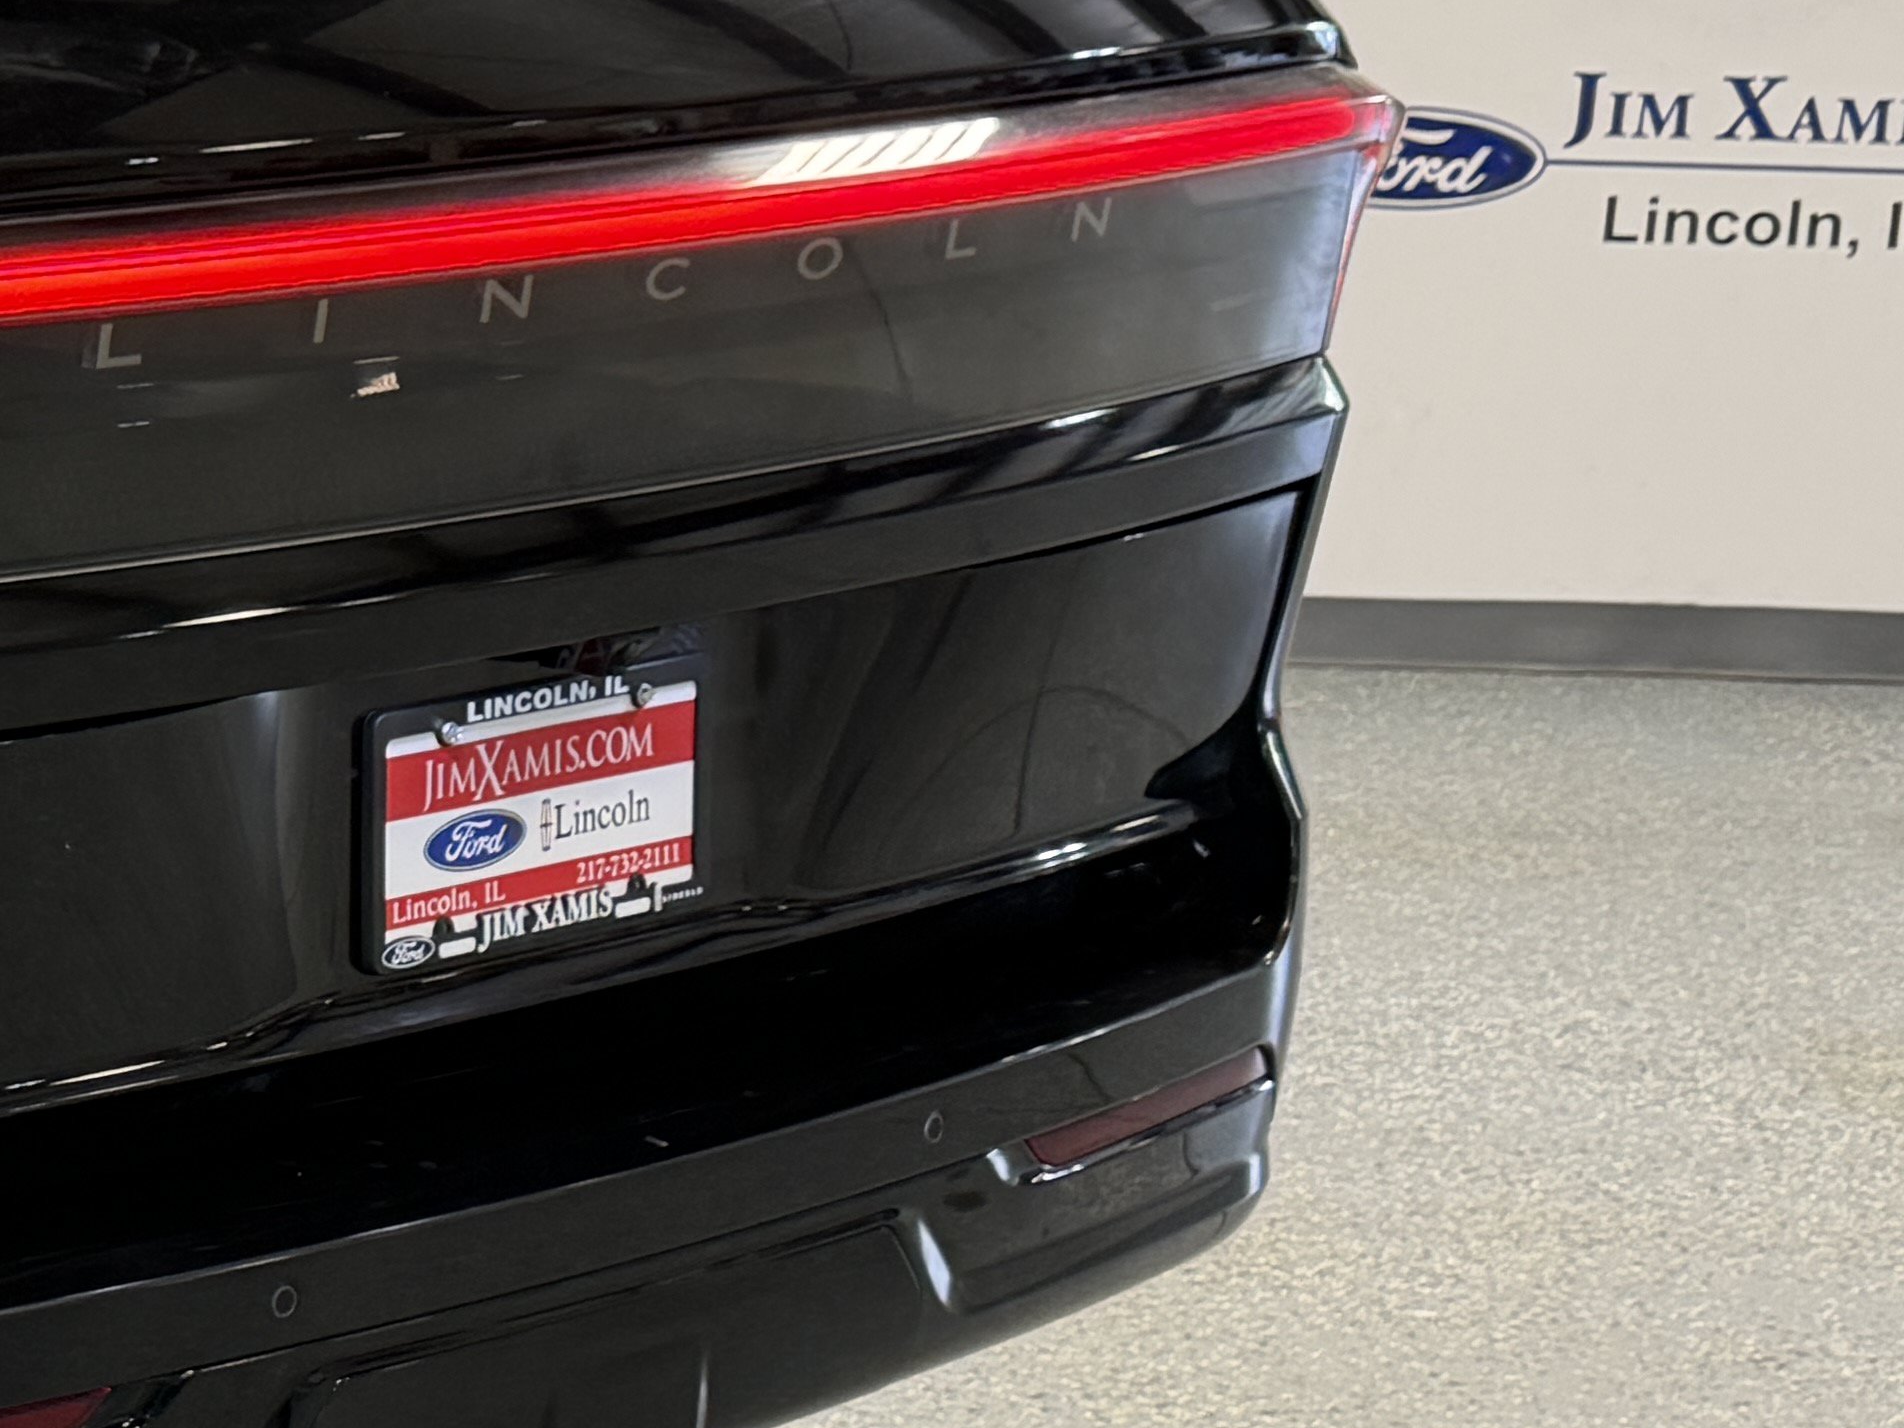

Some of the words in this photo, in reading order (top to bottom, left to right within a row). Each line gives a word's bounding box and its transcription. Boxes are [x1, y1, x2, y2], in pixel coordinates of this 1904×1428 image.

[1564, 72, 1695, 148] JIM
[1603, 195, 1859, 259] Lincoln,
[85, 197, 1112, 369] LINCOLN
[467, 680, 596, 723] LINCOLN,
[604, 675, 629, 696] IL
[422, 722, 654, 812] JIMXAMIS.COM
[445, 818, 505, 862] Ford
[555, 790, 650, 839] Lincoln
[576, 843, 680, 884] 217-732-2111
[392, 886, 478, 925] Lincoln,
[484, 880, 506, 904] IL
[477, 906, 529, 953] JIM
[531, 886, 614, 933] XAMIS
